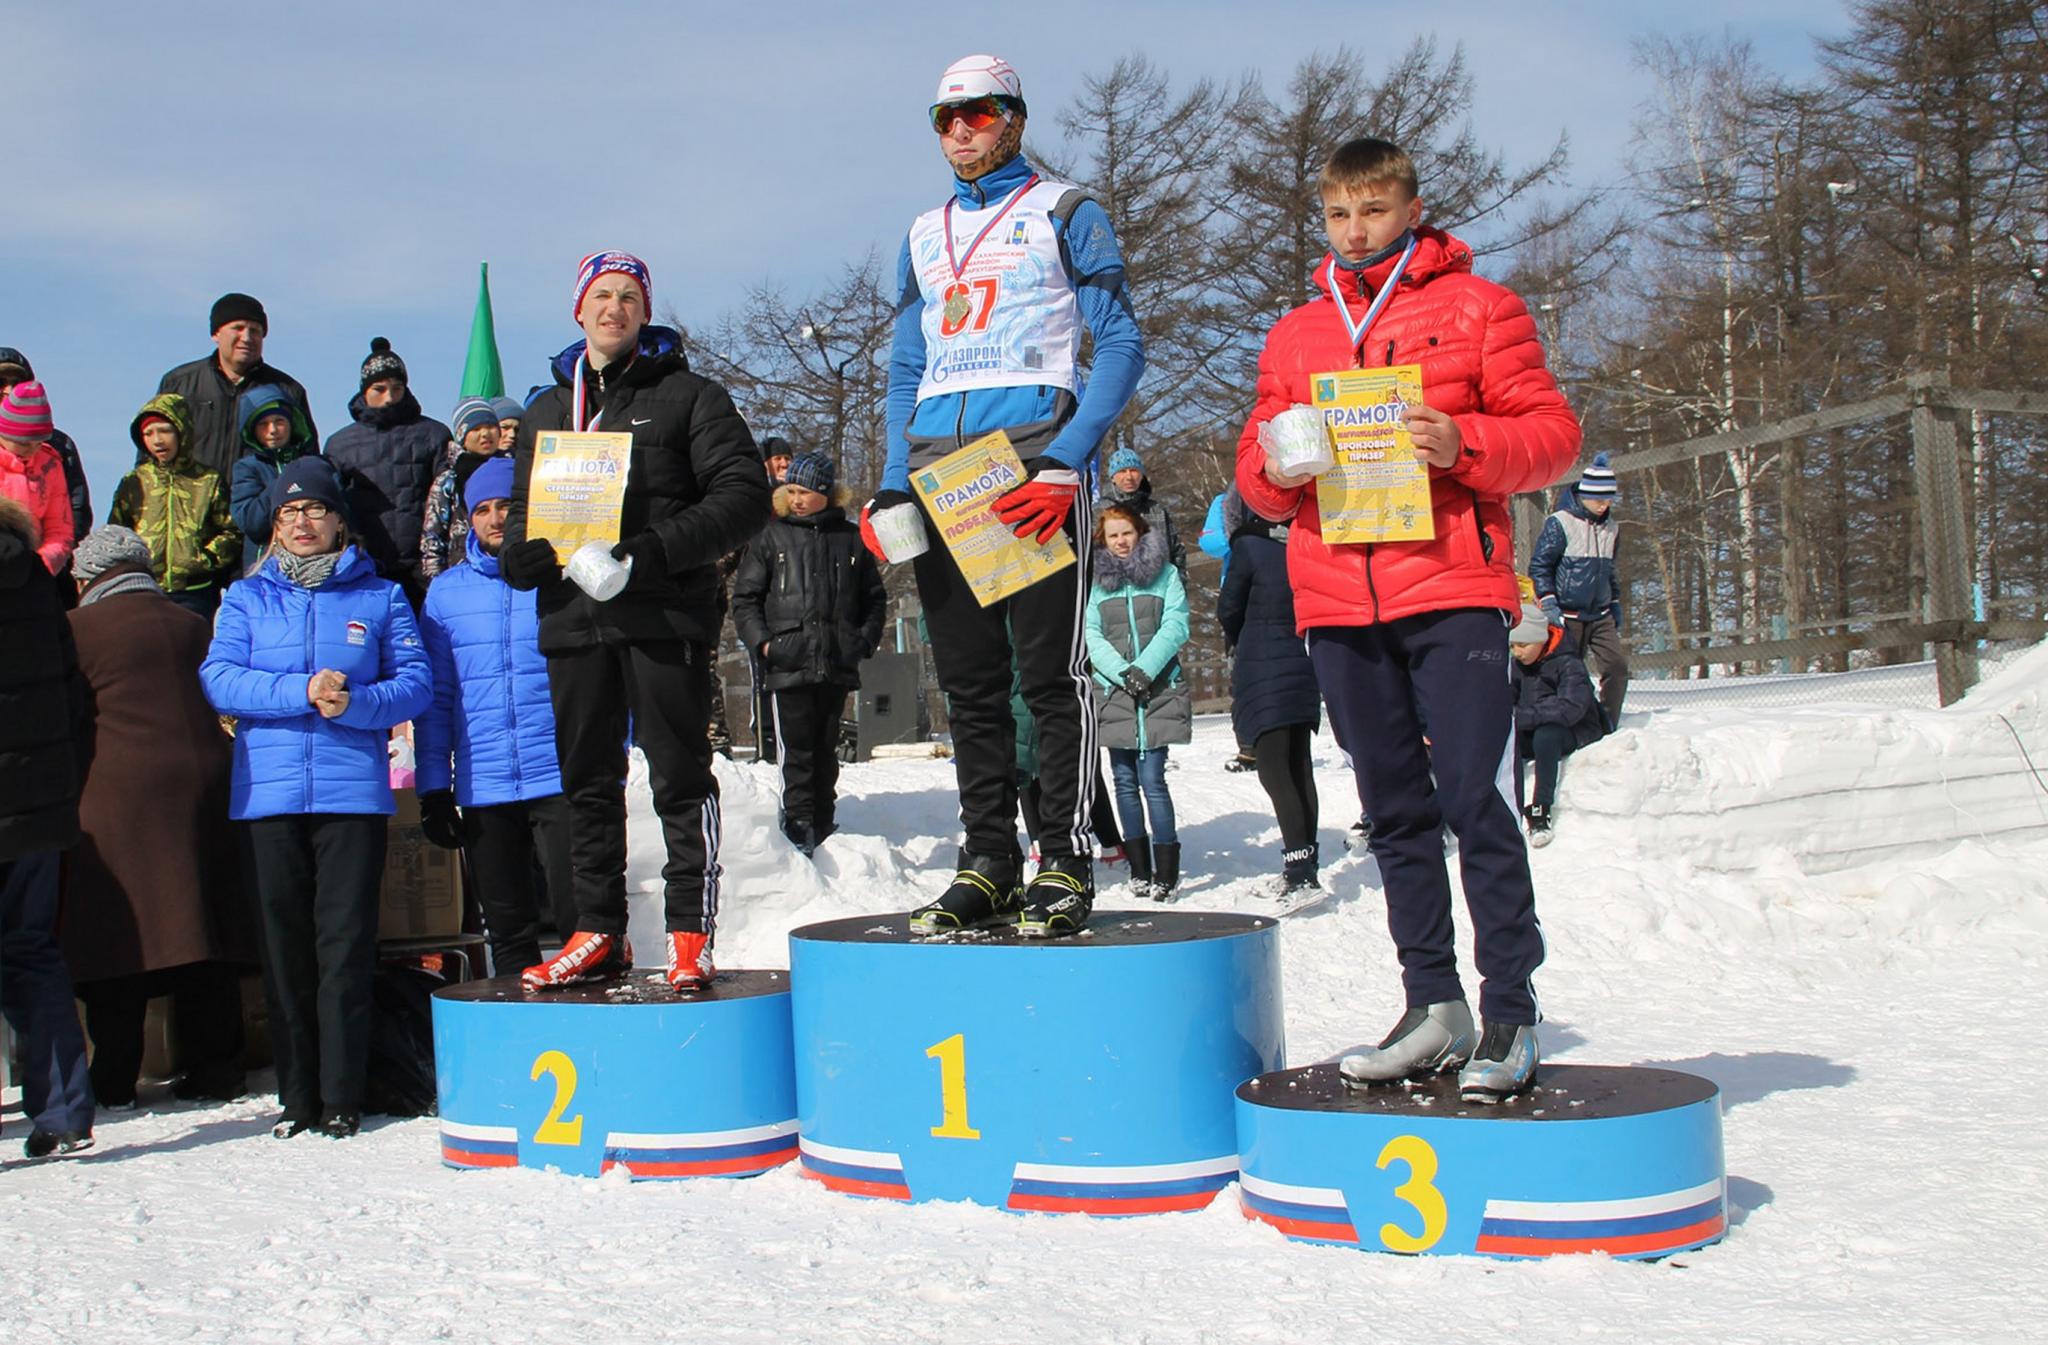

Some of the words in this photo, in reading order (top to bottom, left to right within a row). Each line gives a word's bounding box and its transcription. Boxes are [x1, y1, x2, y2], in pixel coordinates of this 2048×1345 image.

[941, 277, 998, 338] 67
[1336, 440, 1395, 451] БРОНЗОВЫЙ
[1348, 451, 1385, 462] ПРИЗЕР
[935, 467, 1014, 512] ГРАМОТА
[530, 1050, 583, 1146] 2
[925, 1033, 980, 1140] 1
[1376, 1135, 1448, 1253] 3
